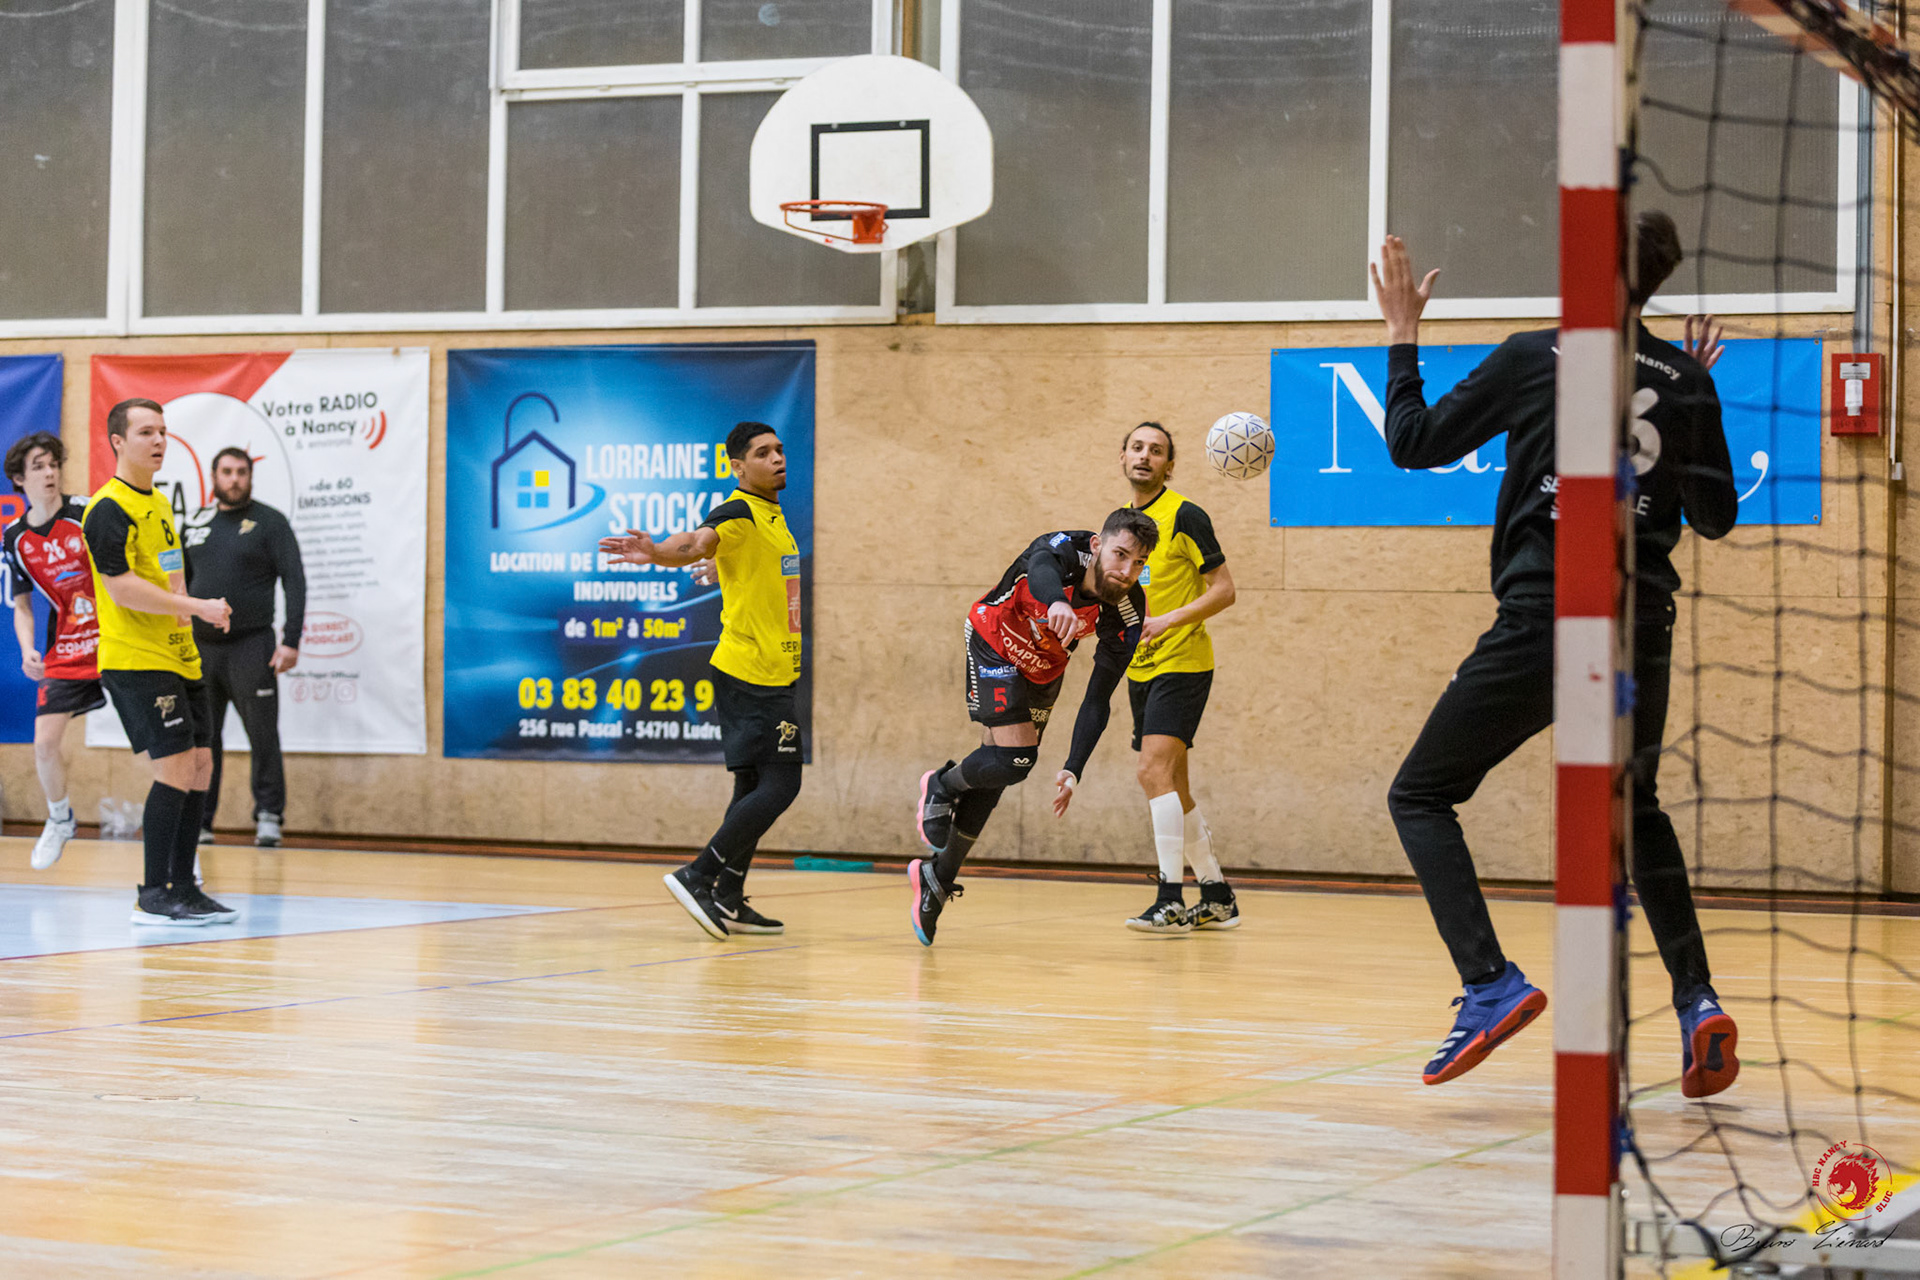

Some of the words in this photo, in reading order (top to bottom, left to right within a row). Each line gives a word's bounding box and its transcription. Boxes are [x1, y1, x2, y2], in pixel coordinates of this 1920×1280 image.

[1634, 353, 1682, 381] Nancy
[263, 401, 313, 417] Votre
[320, 392, 377, 412] RADIO
[303, 420, 356, 436] Nancy
[585, 443, 708, 479] LORRAINE
[715, 443, 739, 479] B
[161, 518, 175, 547] 8
[490, 552, 566, 573] LOCATION
[571, 552, 593, 572] DE
[573, 581, 679, 602] INDIVIDUELS
[564, 617, 587, 639] de
[627, 618, 640, 639] à
[518, 677, 554, 710] 03
[561, 677, 598, 711] 83
[605, 678, 643, 712] 40
[649, 678, 686, 712] 23
[693, 678, 716, 712] 9
[993, 687, 1008, 712] 5
[518, 718, 548, 738] 256
[550, 722, 576, 738] rue
[578, 720, 623, 739] Pascal
[635, 720, 680, 740] 54710
